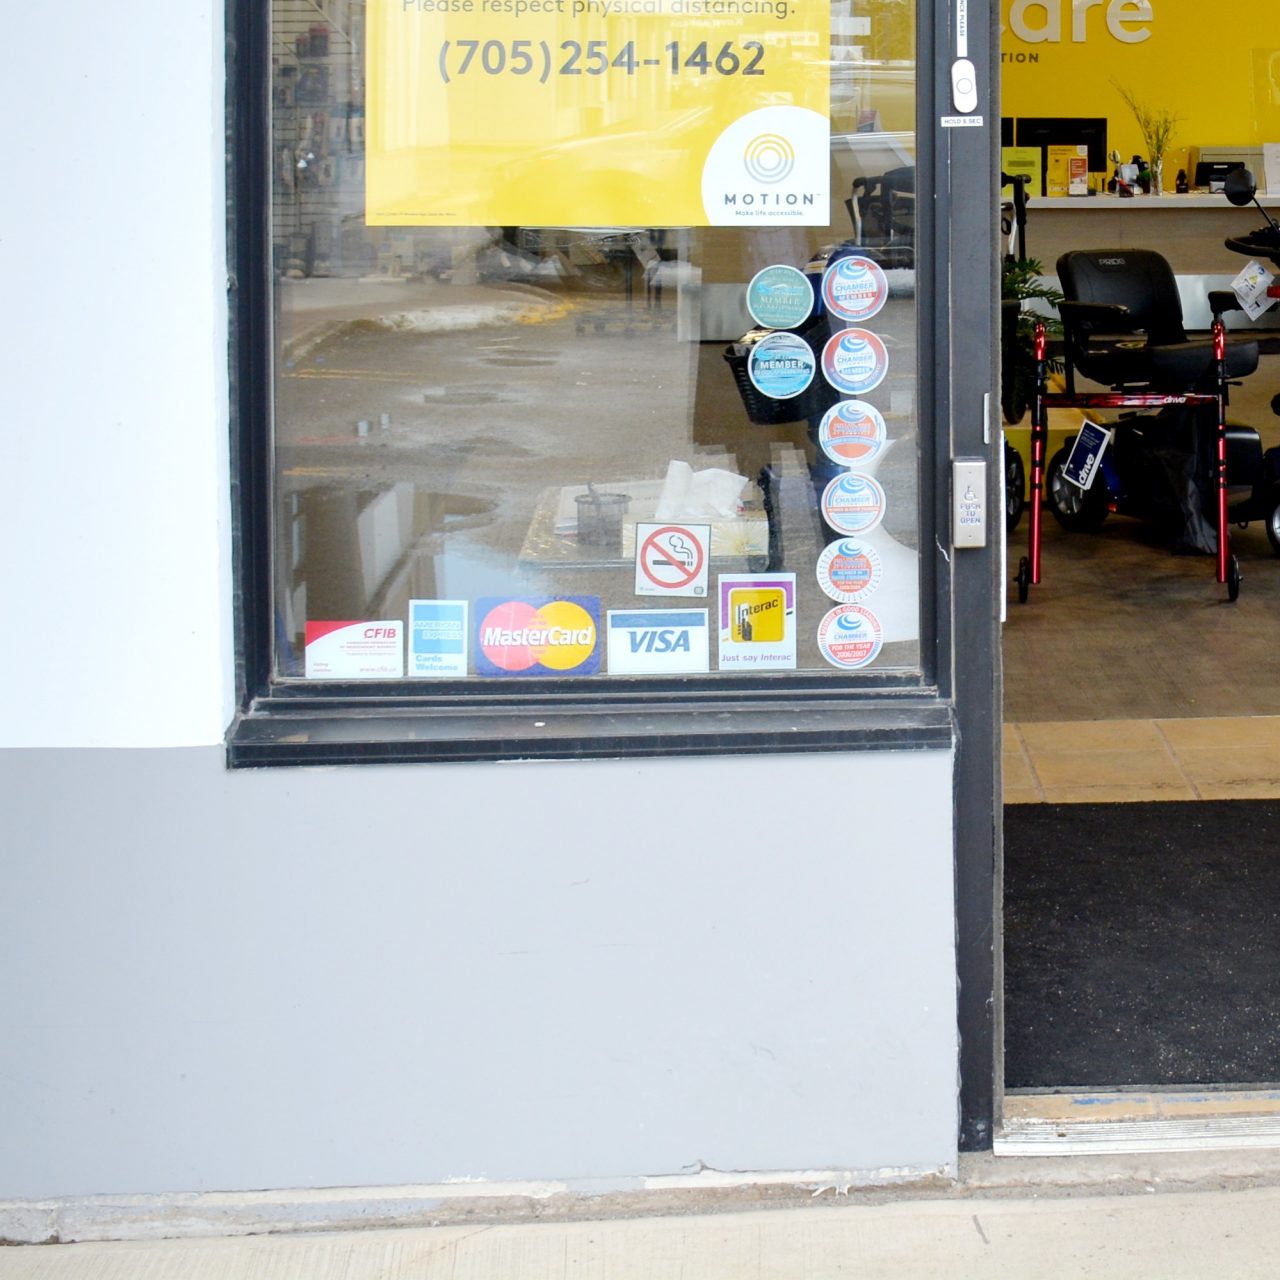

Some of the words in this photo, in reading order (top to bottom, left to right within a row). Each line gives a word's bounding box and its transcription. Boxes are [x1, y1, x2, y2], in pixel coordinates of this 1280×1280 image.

[1001, 53, 1039, 63] TION
[724, 193, 814, 205] MOTION
[760, 361, 804, 369] MEMBER
[1163, 395, 1187, 404] drive
[1078, 453, 1095, 484] drive
[738, 598, 779, 622] Interac
[414, 621, 462, 630] AMERICAN
[363, 628, 397, 639] CFIB
[422, 631, 464, 640] EXPRESS
[483, 626, 592, 648] MasterCard
[627, 630, 690, 653] VISA
[721, 654, 740, 662] Just
[743, 655, 757, 663] say
[760, 654, 792, 662] Interac
